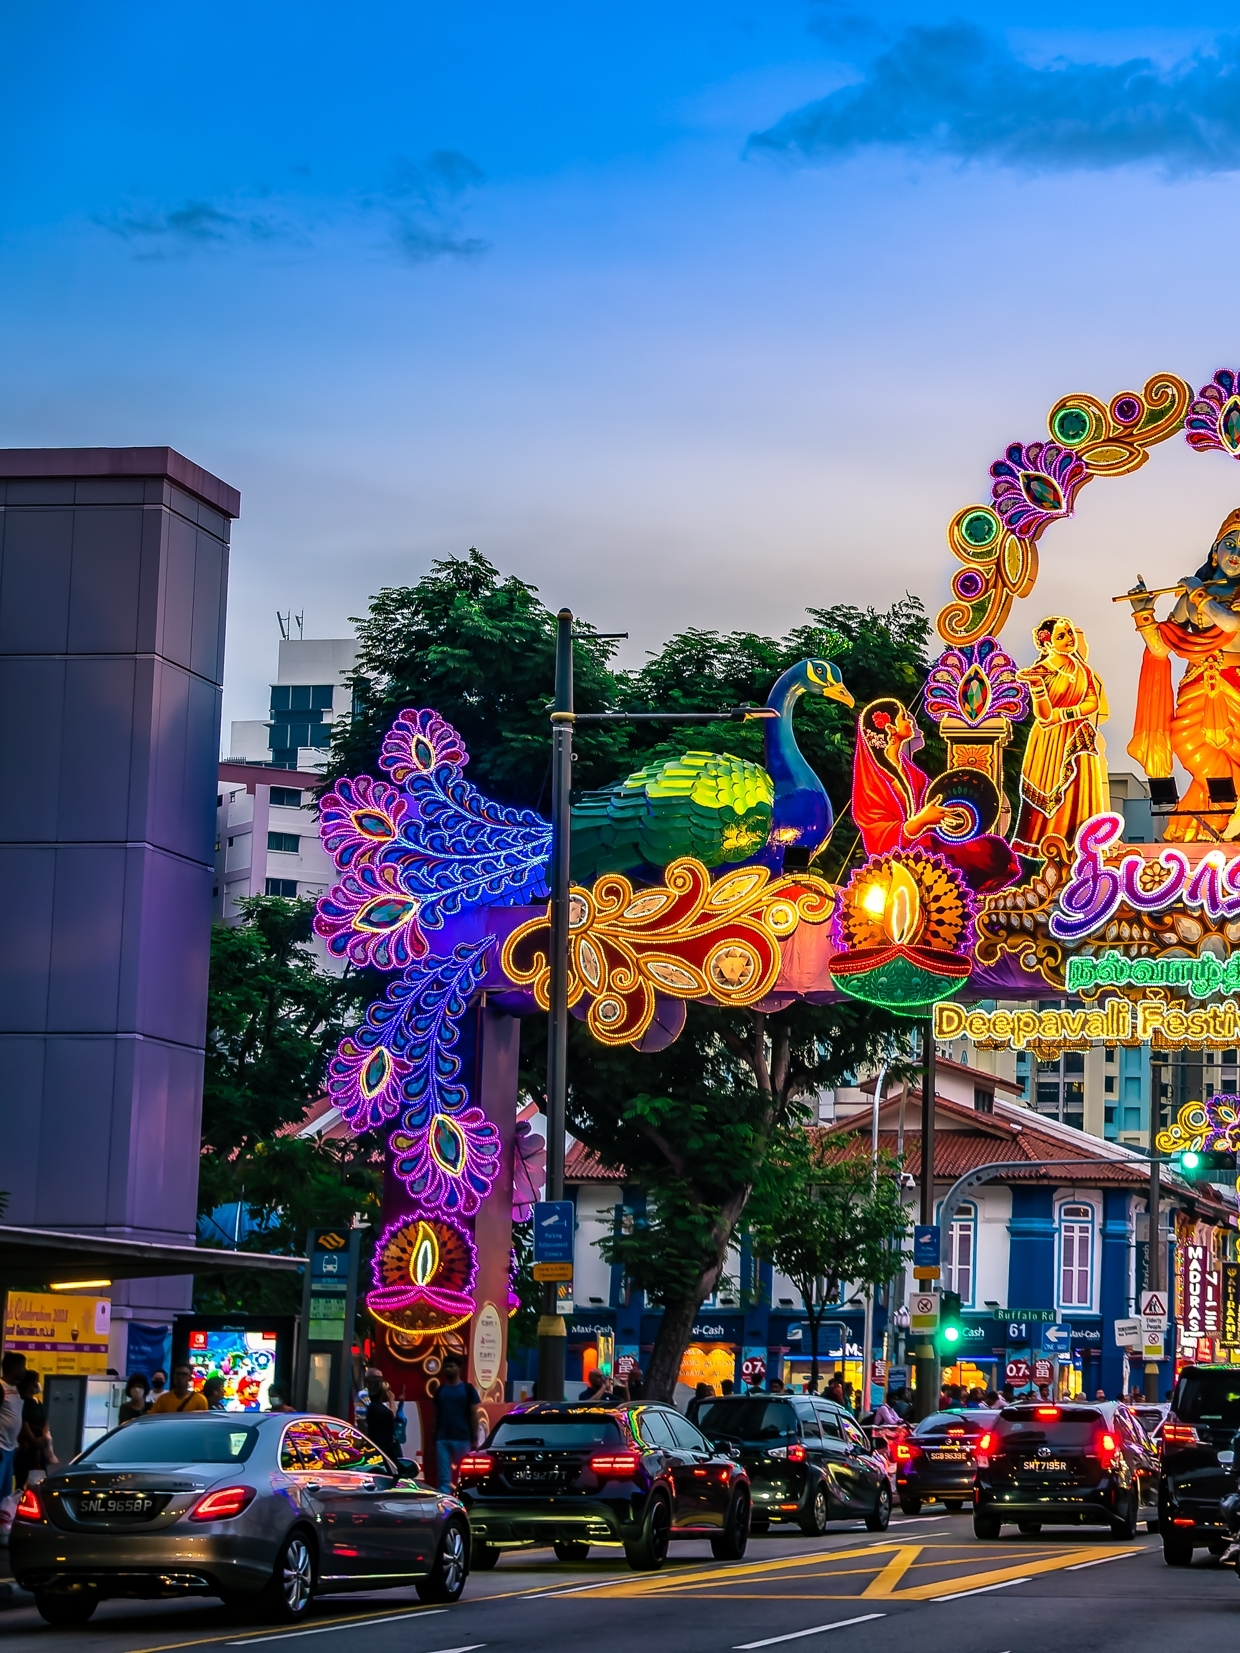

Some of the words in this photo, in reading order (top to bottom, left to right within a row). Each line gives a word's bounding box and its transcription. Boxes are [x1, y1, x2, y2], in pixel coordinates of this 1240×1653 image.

[933, 999, 1130, 1048] Deepavali
[1187, 1246, 1203, 1332] MADURAS
[998, 1310, 1038, 1321] Buffalo
[1042, 1311, 1054, 1321] Rd
[571, 1324, 613, 1334] Maxi-Cash
[692, 1324, 724, 1335] xi-Cash
[1009, 1323, 1026, 1337] 61
